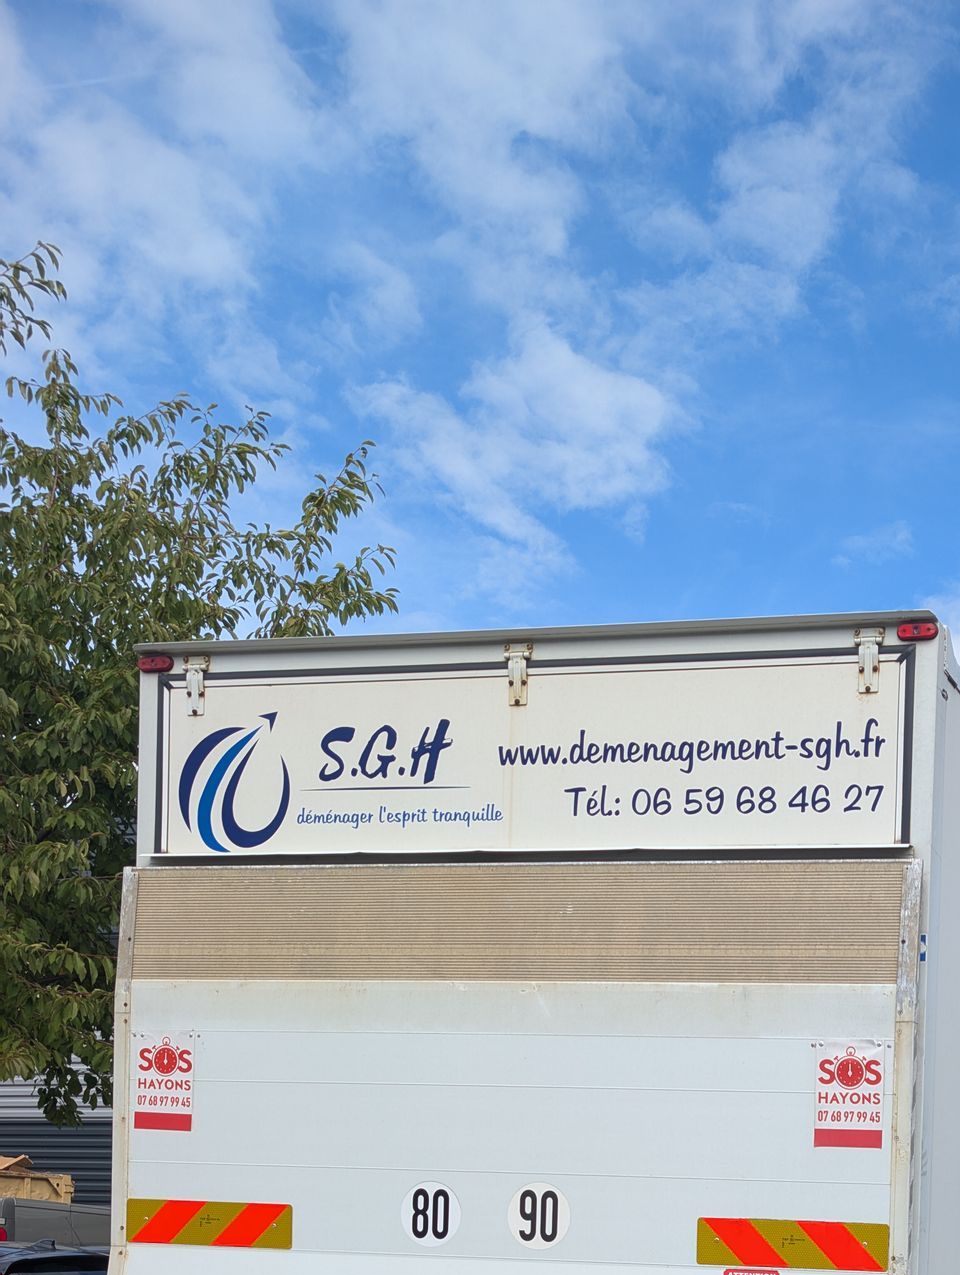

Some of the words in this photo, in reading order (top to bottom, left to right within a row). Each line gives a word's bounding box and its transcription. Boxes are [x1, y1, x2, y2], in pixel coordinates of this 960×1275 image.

[319, 719, 453, 784] S.G.H
[498, 718, 886, 774] www.demenagement-sgh.fr
[297, 807, 373, 830] déménager
[378, 805, 427, 830] l'esprit
[432, 803, 503, 828] tranquille
[564, 785, 621, 817] Tél.:
[631, 786, 672, 816] 06
[683, 786, 725, 816] 59
[736, 785, 778, 815] 68
[788, 784, 831, 814] 46
[843, 784, 885, 813] 27
[138, 1045, 192, 1077] SOS
[818, 1055, 882, 1090] SOS
[138, 1078, 191, 1091] HAYONS
[818, 1092, 881, 1105] HAYONS
[137, 1095, 147, 1106] 07
[148, 1096, 158, 1107] 68
[159, 1096, 169, 1107] 97
[170, 1097, 180, 1108] 99
[181, 1097, 191, 1108] 45
[818, 1110, 828, 1122] 07
[831, 1111, 842, 1122] 68
[844, 1111, 854, 1123] 97
[857, 1112, 867, 1123] 99
[869, 1112, 880, 1123] 45
[411, 1187, 451, 1240] 80
[518, 1189, 559, 1242] 90
